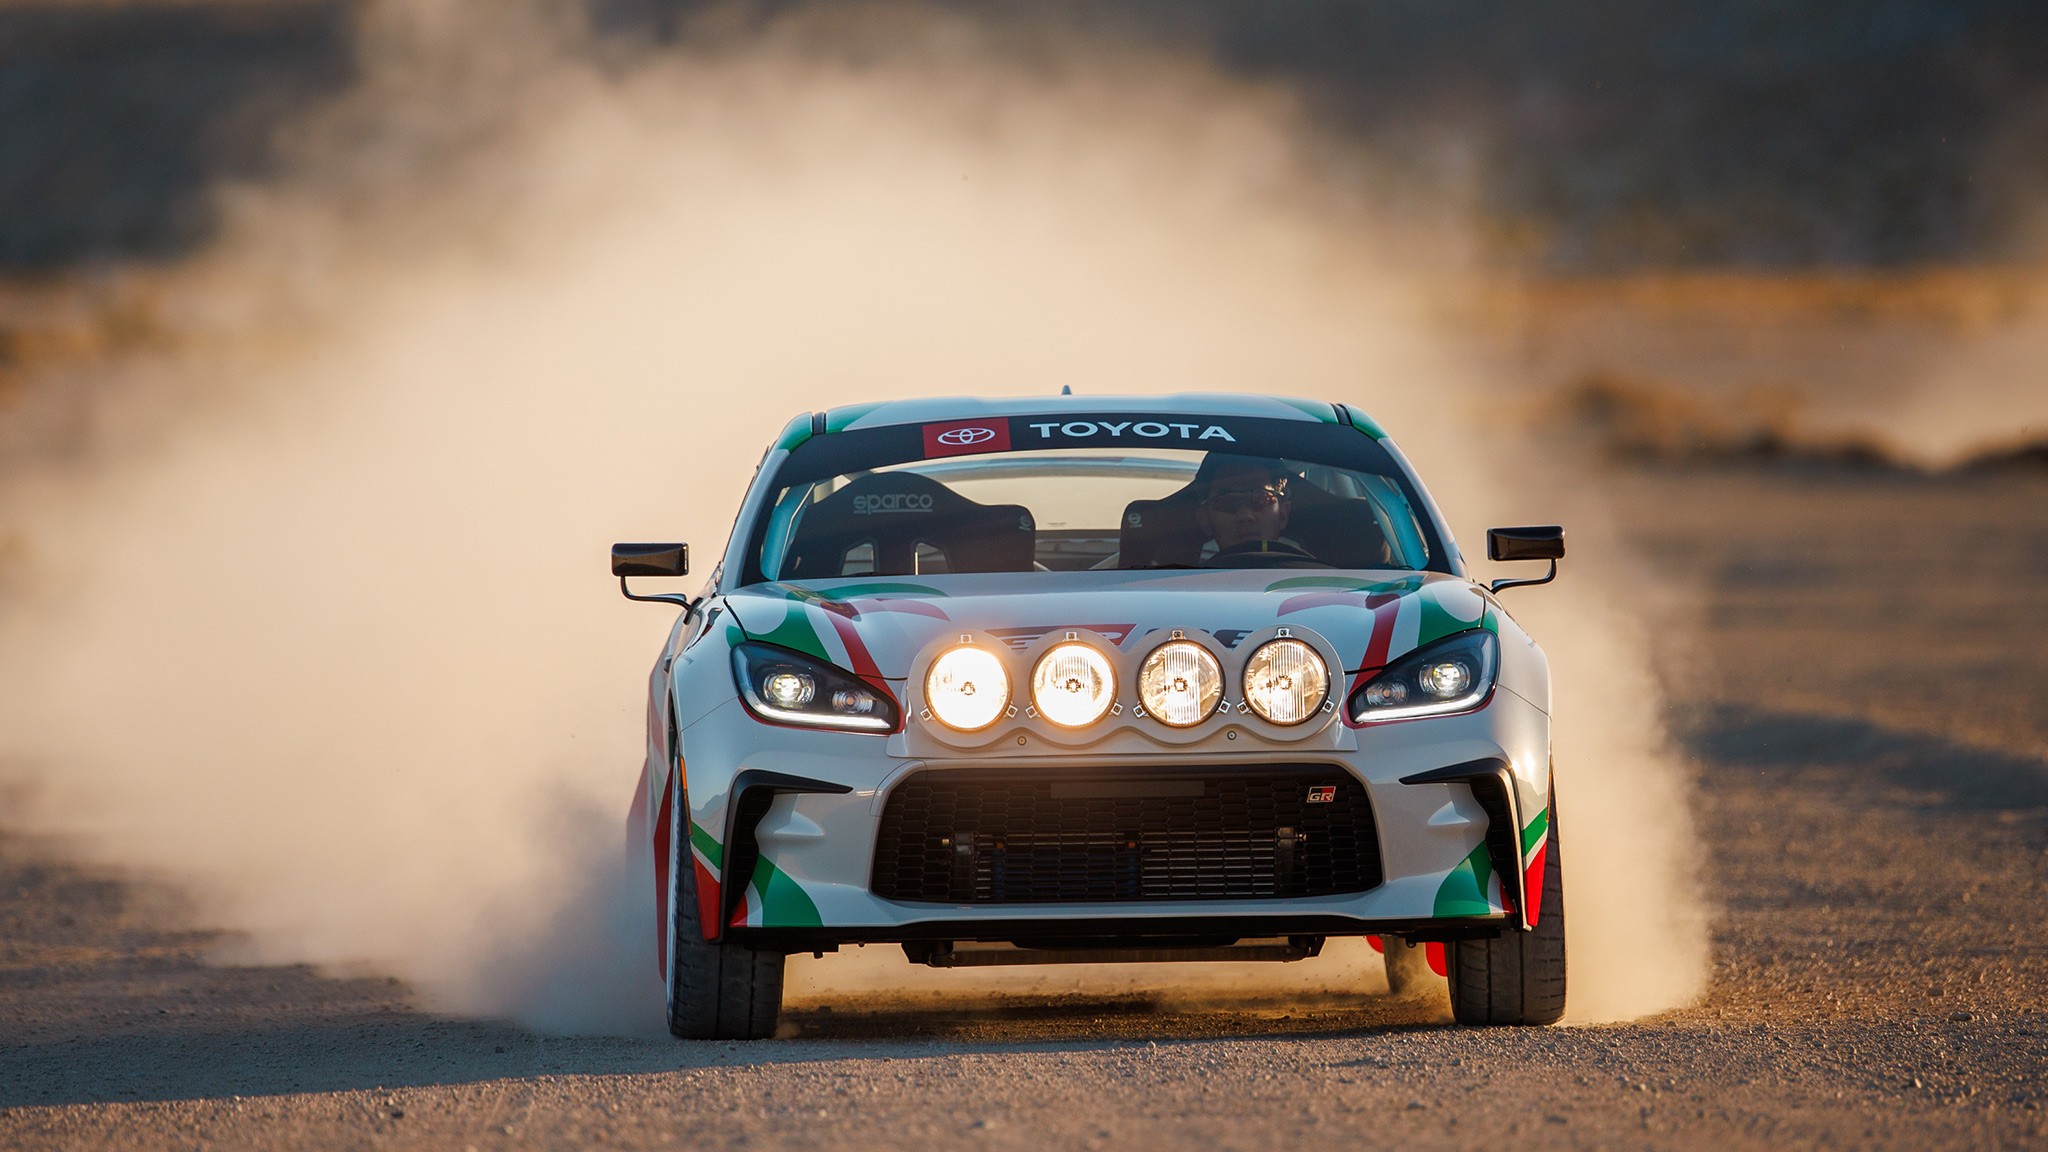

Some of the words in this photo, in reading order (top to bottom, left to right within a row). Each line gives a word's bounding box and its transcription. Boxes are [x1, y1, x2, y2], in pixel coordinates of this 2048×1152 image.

[1029, 421, 1237, 442] TOYOTA
[853, 494, 933, 514] sparco
[1308, 791, 1333, 802] GR
